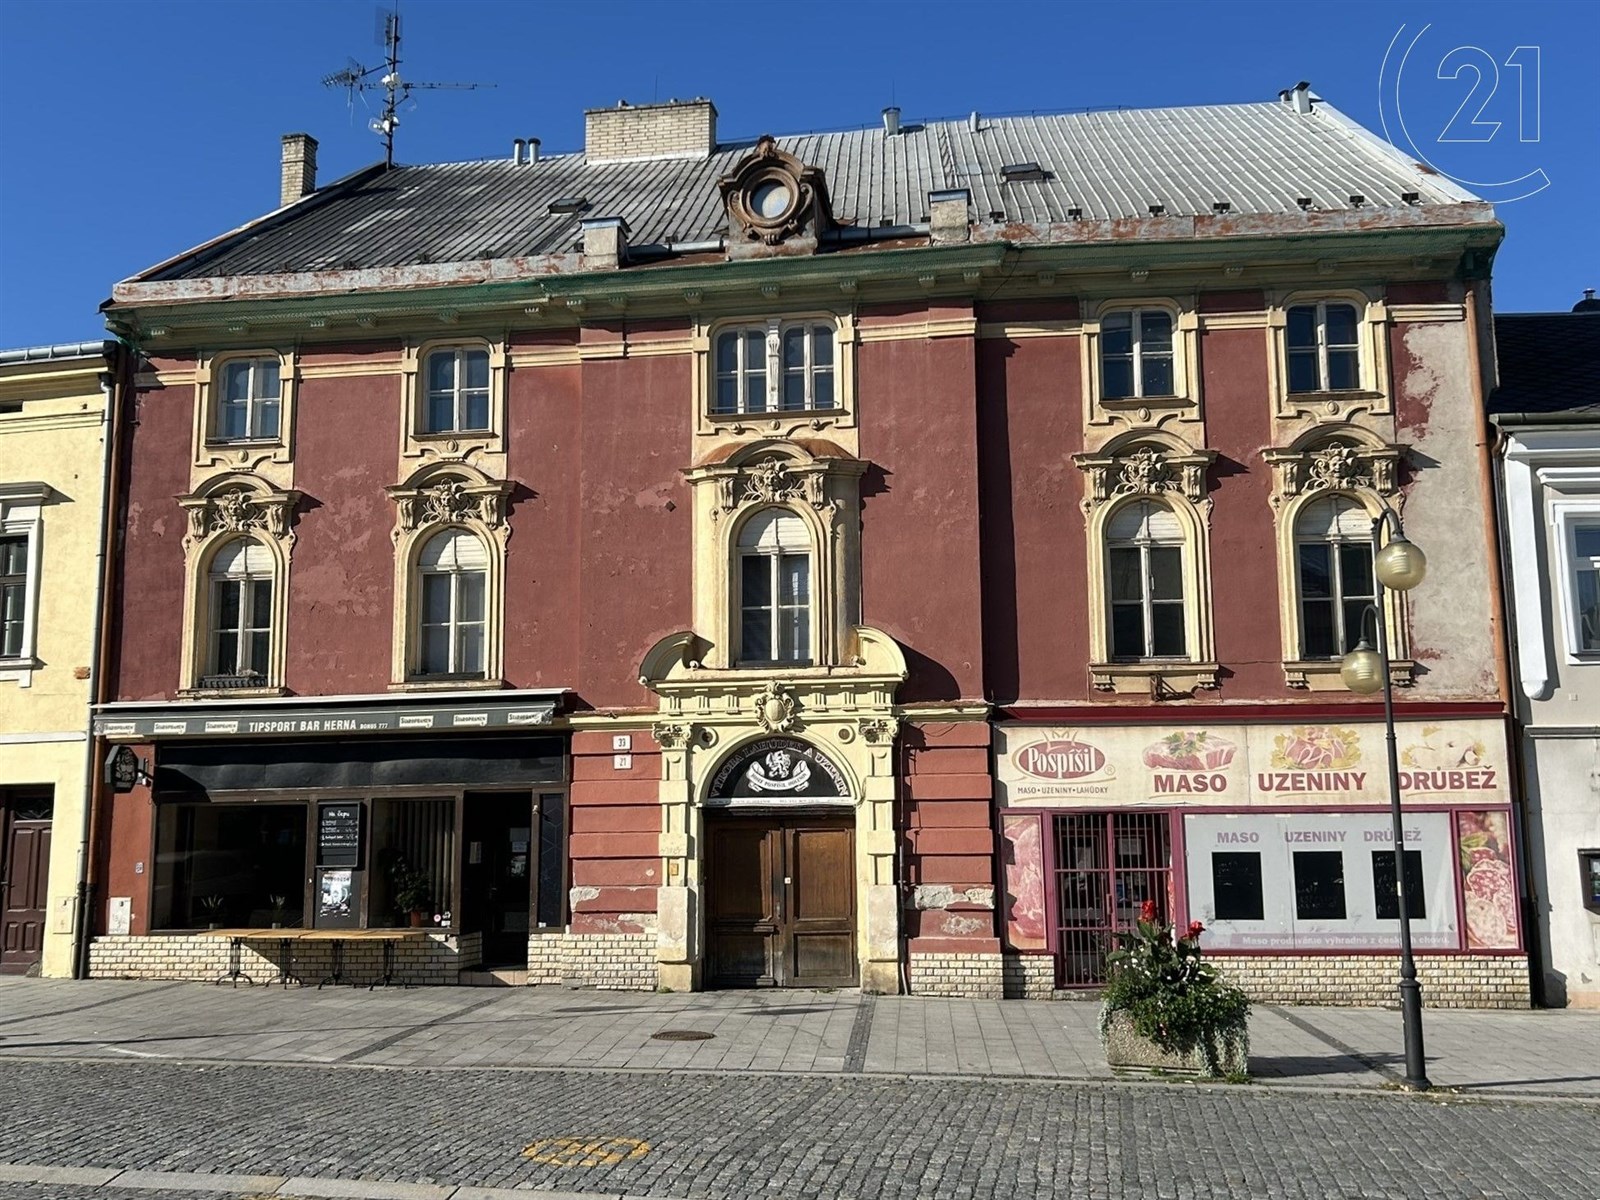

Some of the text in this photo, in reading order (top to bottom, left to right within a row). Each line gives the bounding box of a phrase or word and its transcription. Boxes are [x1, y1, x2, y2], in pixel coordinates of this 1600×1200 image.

[249, 721, 296, 732] TIPSPORT
[300, 720, 320, 731] BAR
[324, 720, 356, 730] HERNA
[802, 747, 813, 758] A
[1027, 746, 1096, 779] Pospíšil
[1154, 765, 1497, 793] MASO UZENINY DRŮBEŽ
[1018, 786, 1036, 794] MASO
[1041, 786, 1072, 794] UZENINY
[1217, 827, 1422, 844] MASO UZENINY DRŮEŽ
[1242, 936, 1267, 945] Maso
